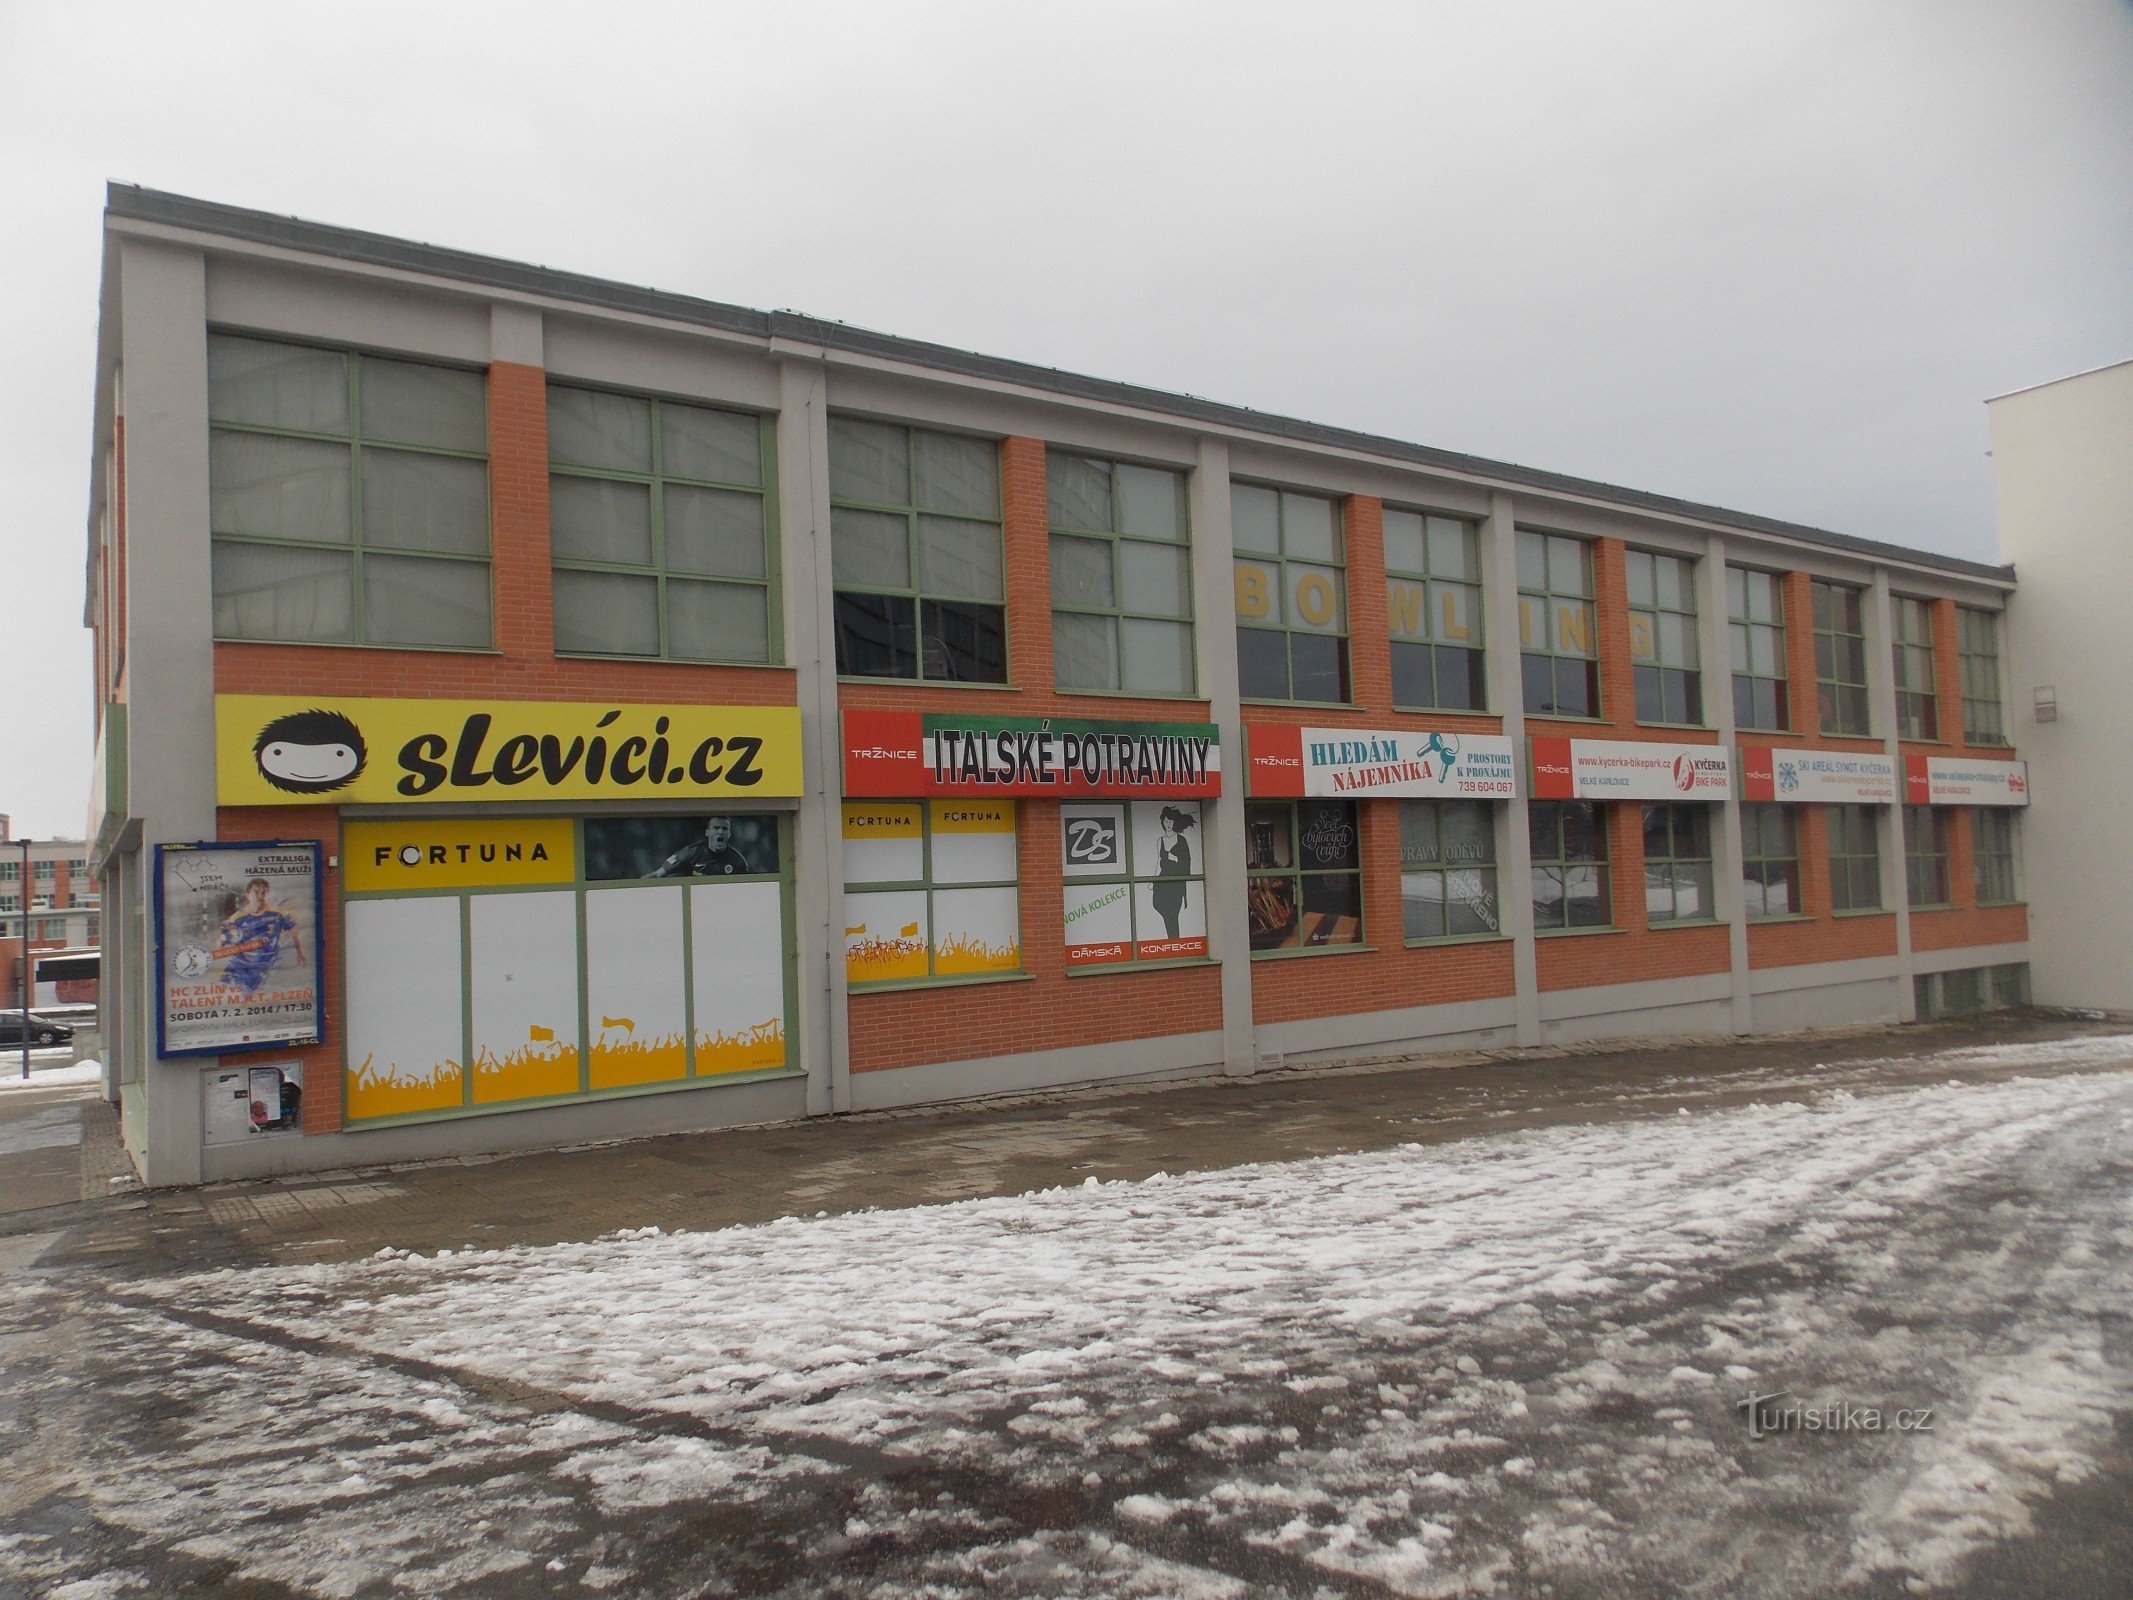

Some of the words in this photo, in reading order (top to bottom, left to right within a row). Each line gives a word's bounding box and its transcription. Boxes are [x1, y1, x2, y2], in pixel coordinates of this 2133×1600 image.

[851, 746, 917, 759] TRŽNICE
[932, 719, 1056, 785] ITALSKÉ
[1061, 733, 1211, 786] POTRAVINY
[1309, 735, 1399, 767] HLEDÁM
[1253, 755, 1300, 767] TRŽNICE
[1466, 753, 1512, 765] PROSTORY
[1577, 756, 1671, 770] www.kycerka-bikepark.cz
[1694, 758, 1727, 771] KYČERKA
[1456, 767, 1464, 777] K
[1465, 767, 1513, 779] PRONÁJMU
[1536, 765, 1570, 774] TRŽNICE
[1798, 760, 1810, 772] SKI
[1835, 762, 1858, 773] SYNOT
[1860, 761, 1891, 775] KYČERKA
[1331, 758, 1433, 792] NÁJEMNÍKA
[1579, 776, 1598, 786] VELKÉ
[1598, 777, 1630, 787] KARLOVICE
[1457, 781, 1476, 792] 739
[1477, 781, 1496, 792] 604
[1496, 782, 1513, 793] 067
[1695, 777, 1710, 787] BIKE
[1710, 778, 1728, 787] PARK
[849, 815, 911, 826] FORTUNA
[944, 812, 1001, 822] FORTUNA
[258, 855, 311, 863] EXTRALIGA
[374, 842, 549, 867] FORTUNA
[1401, 846, 1438, 861] PRAVY
[245, 866, 284, 874] HÁZENÁ
[1087, 886, 1127, 913] KOLEKCE
[1071, 947, 1122, 959] DÁMSKÁ
[1140, 941, 1203, 954] KONFEKCE
[170, 987, 189, 997] HC
[193, 983, 224, 996] ZLÍN
[170, 996, 223, 1009] TALENT
[227, 993, 268, 1004] M.A.T.
[271, 987, 313, 1002] PLZEŇ
[170, 1011, 219, 1022] SOBOTA
[222, 1009, 232, 1018] 7.
[234, 1008, 244, 1016] 2.
[247, 1004, 273, 1015] 2014
[284, 1002, 313, 1012] 17:30
